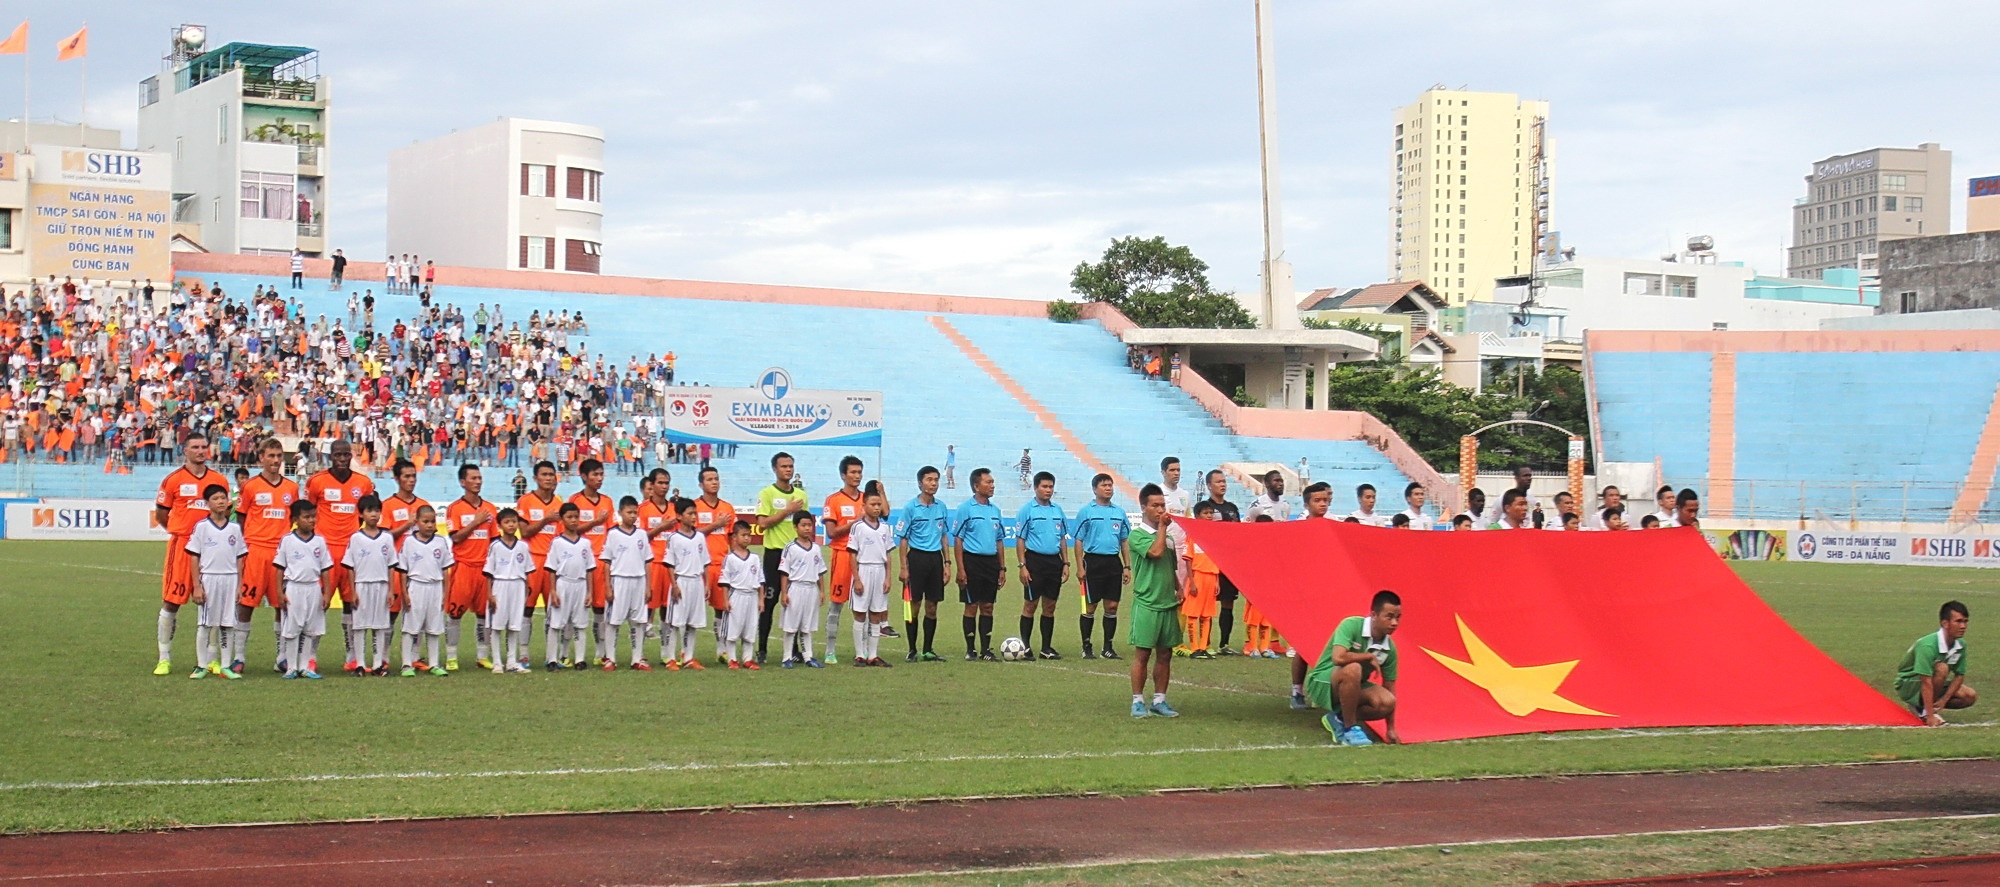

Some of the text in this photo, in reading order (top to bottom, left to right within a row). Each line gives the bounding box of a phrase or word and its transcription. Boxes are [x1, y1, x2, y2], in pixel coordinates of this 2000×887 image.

[87, 153, 141, 176] SHB
[69, 189, 134, 205] NGÂN HÀNG
[36, 206, 68, 217] TMCP
[71, 206, 90, 219] SÀI
[93, 207, 117, 220] GÒN
[127, 209, 143, 222] HÀ
[146, 210, 166, 225] NỘI
[47, 222, 67, 235] GIỮ
[70, 225, 101, 238] TRỌN
[136, 229, 155, 239] TIN
[106, 260, 130, 273] BẠN
[732, 402, 816, 418] EXIMBANK
[837, 419, 879, 428] EXIMBANK
[57, 508, 110, 529] SHB
[1821, 536, 1837, 546] CÔNG
[1838, 537, 1844, 546] TY
[1882, 538, 1897, 547] THAO
[1928, 538, 1966, 557] SHB
[1826, 550, 1843, 559] SHB
[171, 582, 186, 597] 20
[241, 583, 257, 600] 24
[832, 584, 843, 597] 15
[450, 602, 464, 617] 26
